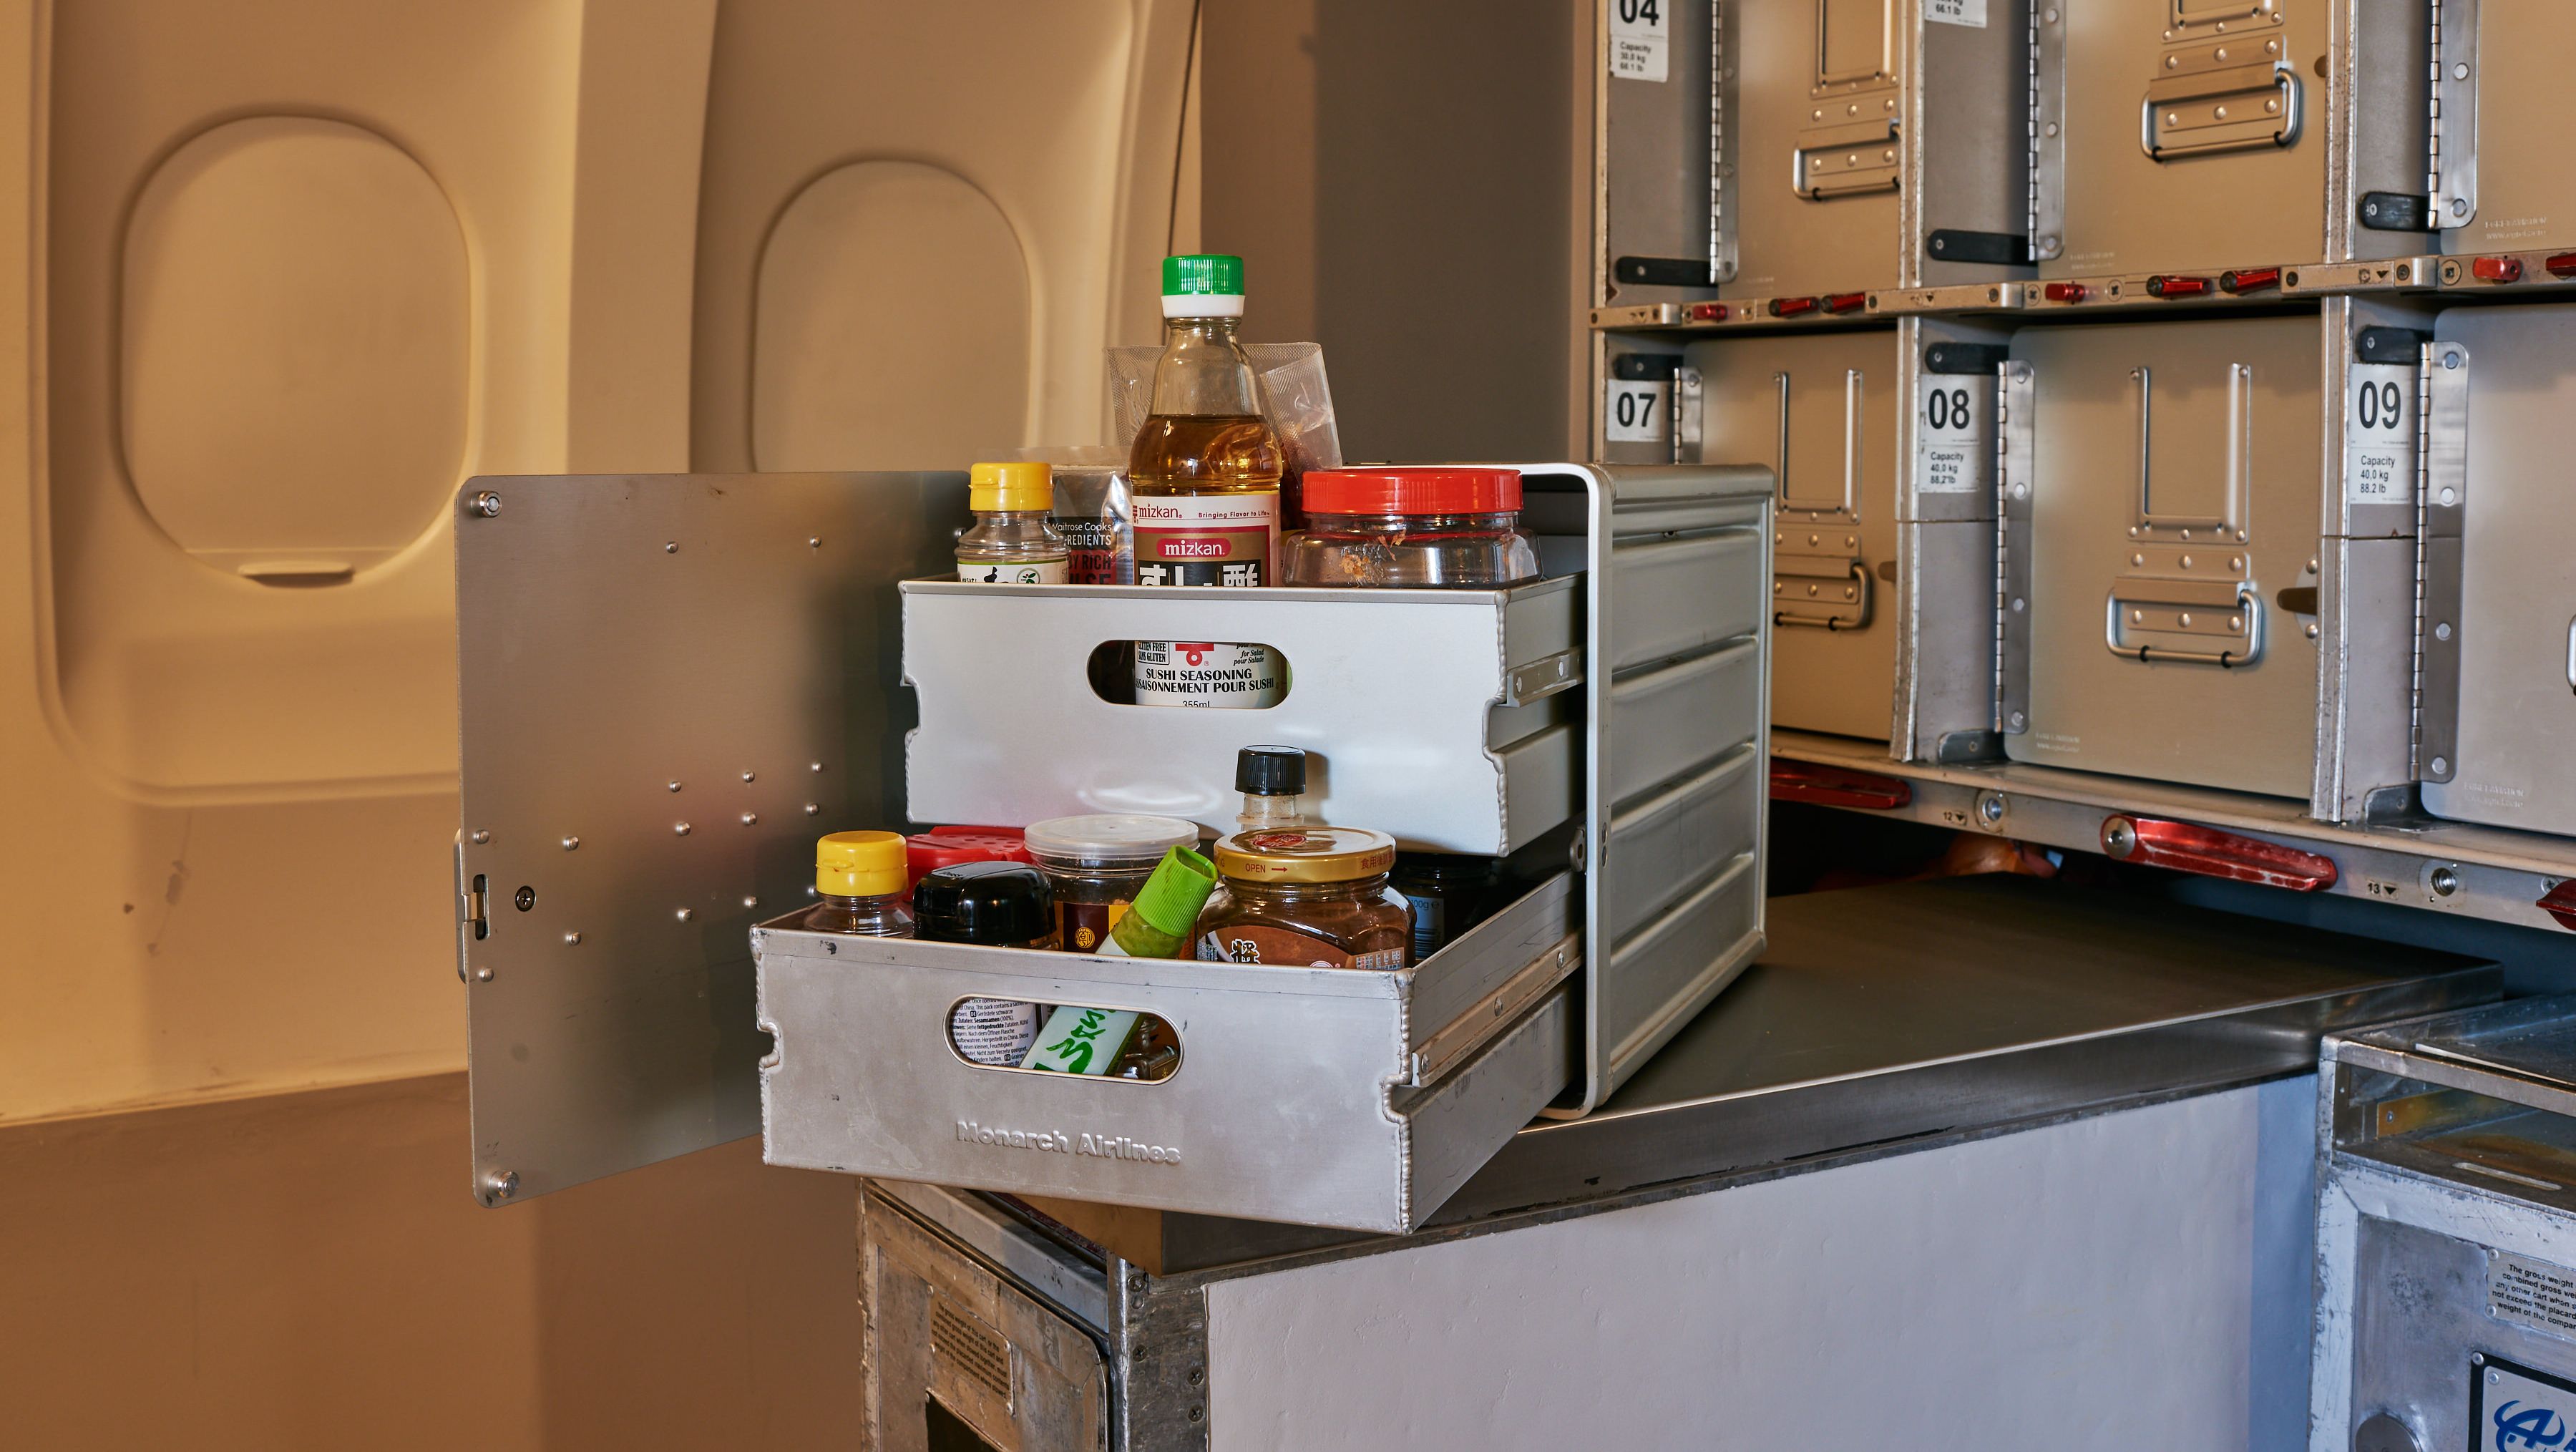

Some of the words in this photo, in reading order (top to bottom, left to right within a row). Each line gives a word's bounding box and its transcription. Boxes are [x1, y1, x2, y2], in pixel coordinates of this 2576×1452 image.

[1619, 0, 1659, 26] 04
[1619, 42, 1652, 54] Capacity
[1617, 391, 1657, 428] 07
[1928, 389, 1970, 429] 08
[2359, 381, 2401, 429] 09
[1931, 452, 1964, 463] Capacity
[2361, 455, 2395, 467] Capacity
[1948, 464, 1958, 474] kg
[2379, 469, 2389, 482] kg
[2360, 483, 2376, 494] 88.2
[2379, 483, 2386, 493] lb
[1139, 503, 1179, 518] mizkan
[1050, 522, 1083, 531] Waitrose
[1066, 535, 1111, 545] REDIENTS
[1165, 540, 1222, 556] mizkan
[1082, 554, 1111, 570] RICH
[1152, 643, 1166, 652] FREE
[1146, 652, 1166, 663] GLUTEN
[1146, 668, 1176, 681] SUSHI
[1180, 668, 1252, 681] SEASONING
[1136, 678, 1210, 693] SSAISONNEMENT
[1214, 681, 1246, 693] POUR
[1249, 677, 1274, 691] SUSHI
[1943, 811, 1952, 821] 12
[1246, 864, 1266, 873] OPEN
[2368, 882, 2380, 894] 13
[957, 1121, 1068, 1154] Monarch
[1075, 1133, 1181, 1164] Airlines
[2509, 1264, 2522, 1274] The
[2524, 1270, 2546, 1280] gross
[2547, 1276, 2574, 1288] weight
[2502, 1273, 2539, 1288] combined
[2540, 1284, 2562, 1295] gross
[2492, 1290, 2504, 1299] not
[2506, 1294, 2532, 1307] exceed
[2534, 1302, 2547, 1311] the
[2496, 1282, 2509, 1292] any
[2511, 1285, 2531, 1296] other
[2533, 1292, 2547, 1301] cart
[2550, 1297, 2570, 1307] when
[2497, 1302, 2522, 1314] weight
[2533, 1312, 2545, 1321] the
[2547, 1317, 2576, 1330] compar
